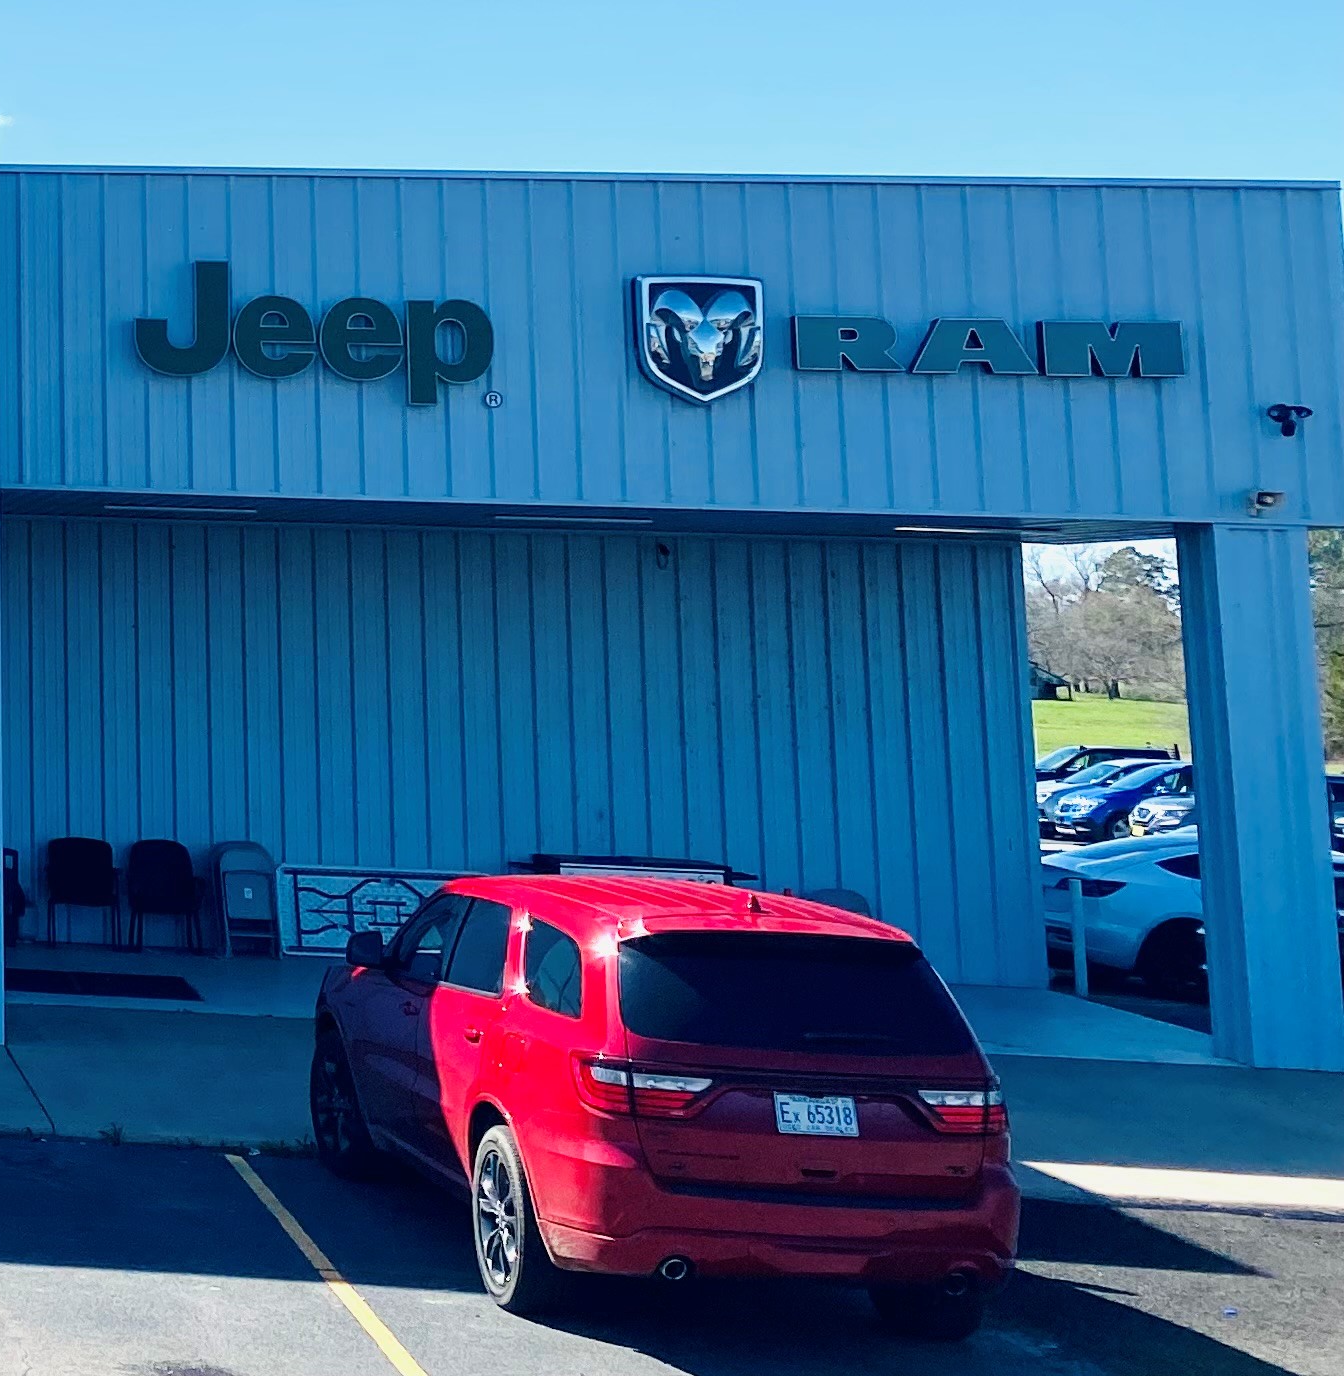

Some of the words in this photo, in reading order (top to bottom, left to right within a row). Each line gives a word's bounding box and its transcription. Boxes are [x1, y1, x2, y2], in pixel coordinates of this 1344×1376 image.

[134, 259, 495, 406] Jeep
[792, 314, 1186, 377] RAM
[807, 1104, 853, 1126] 65318
